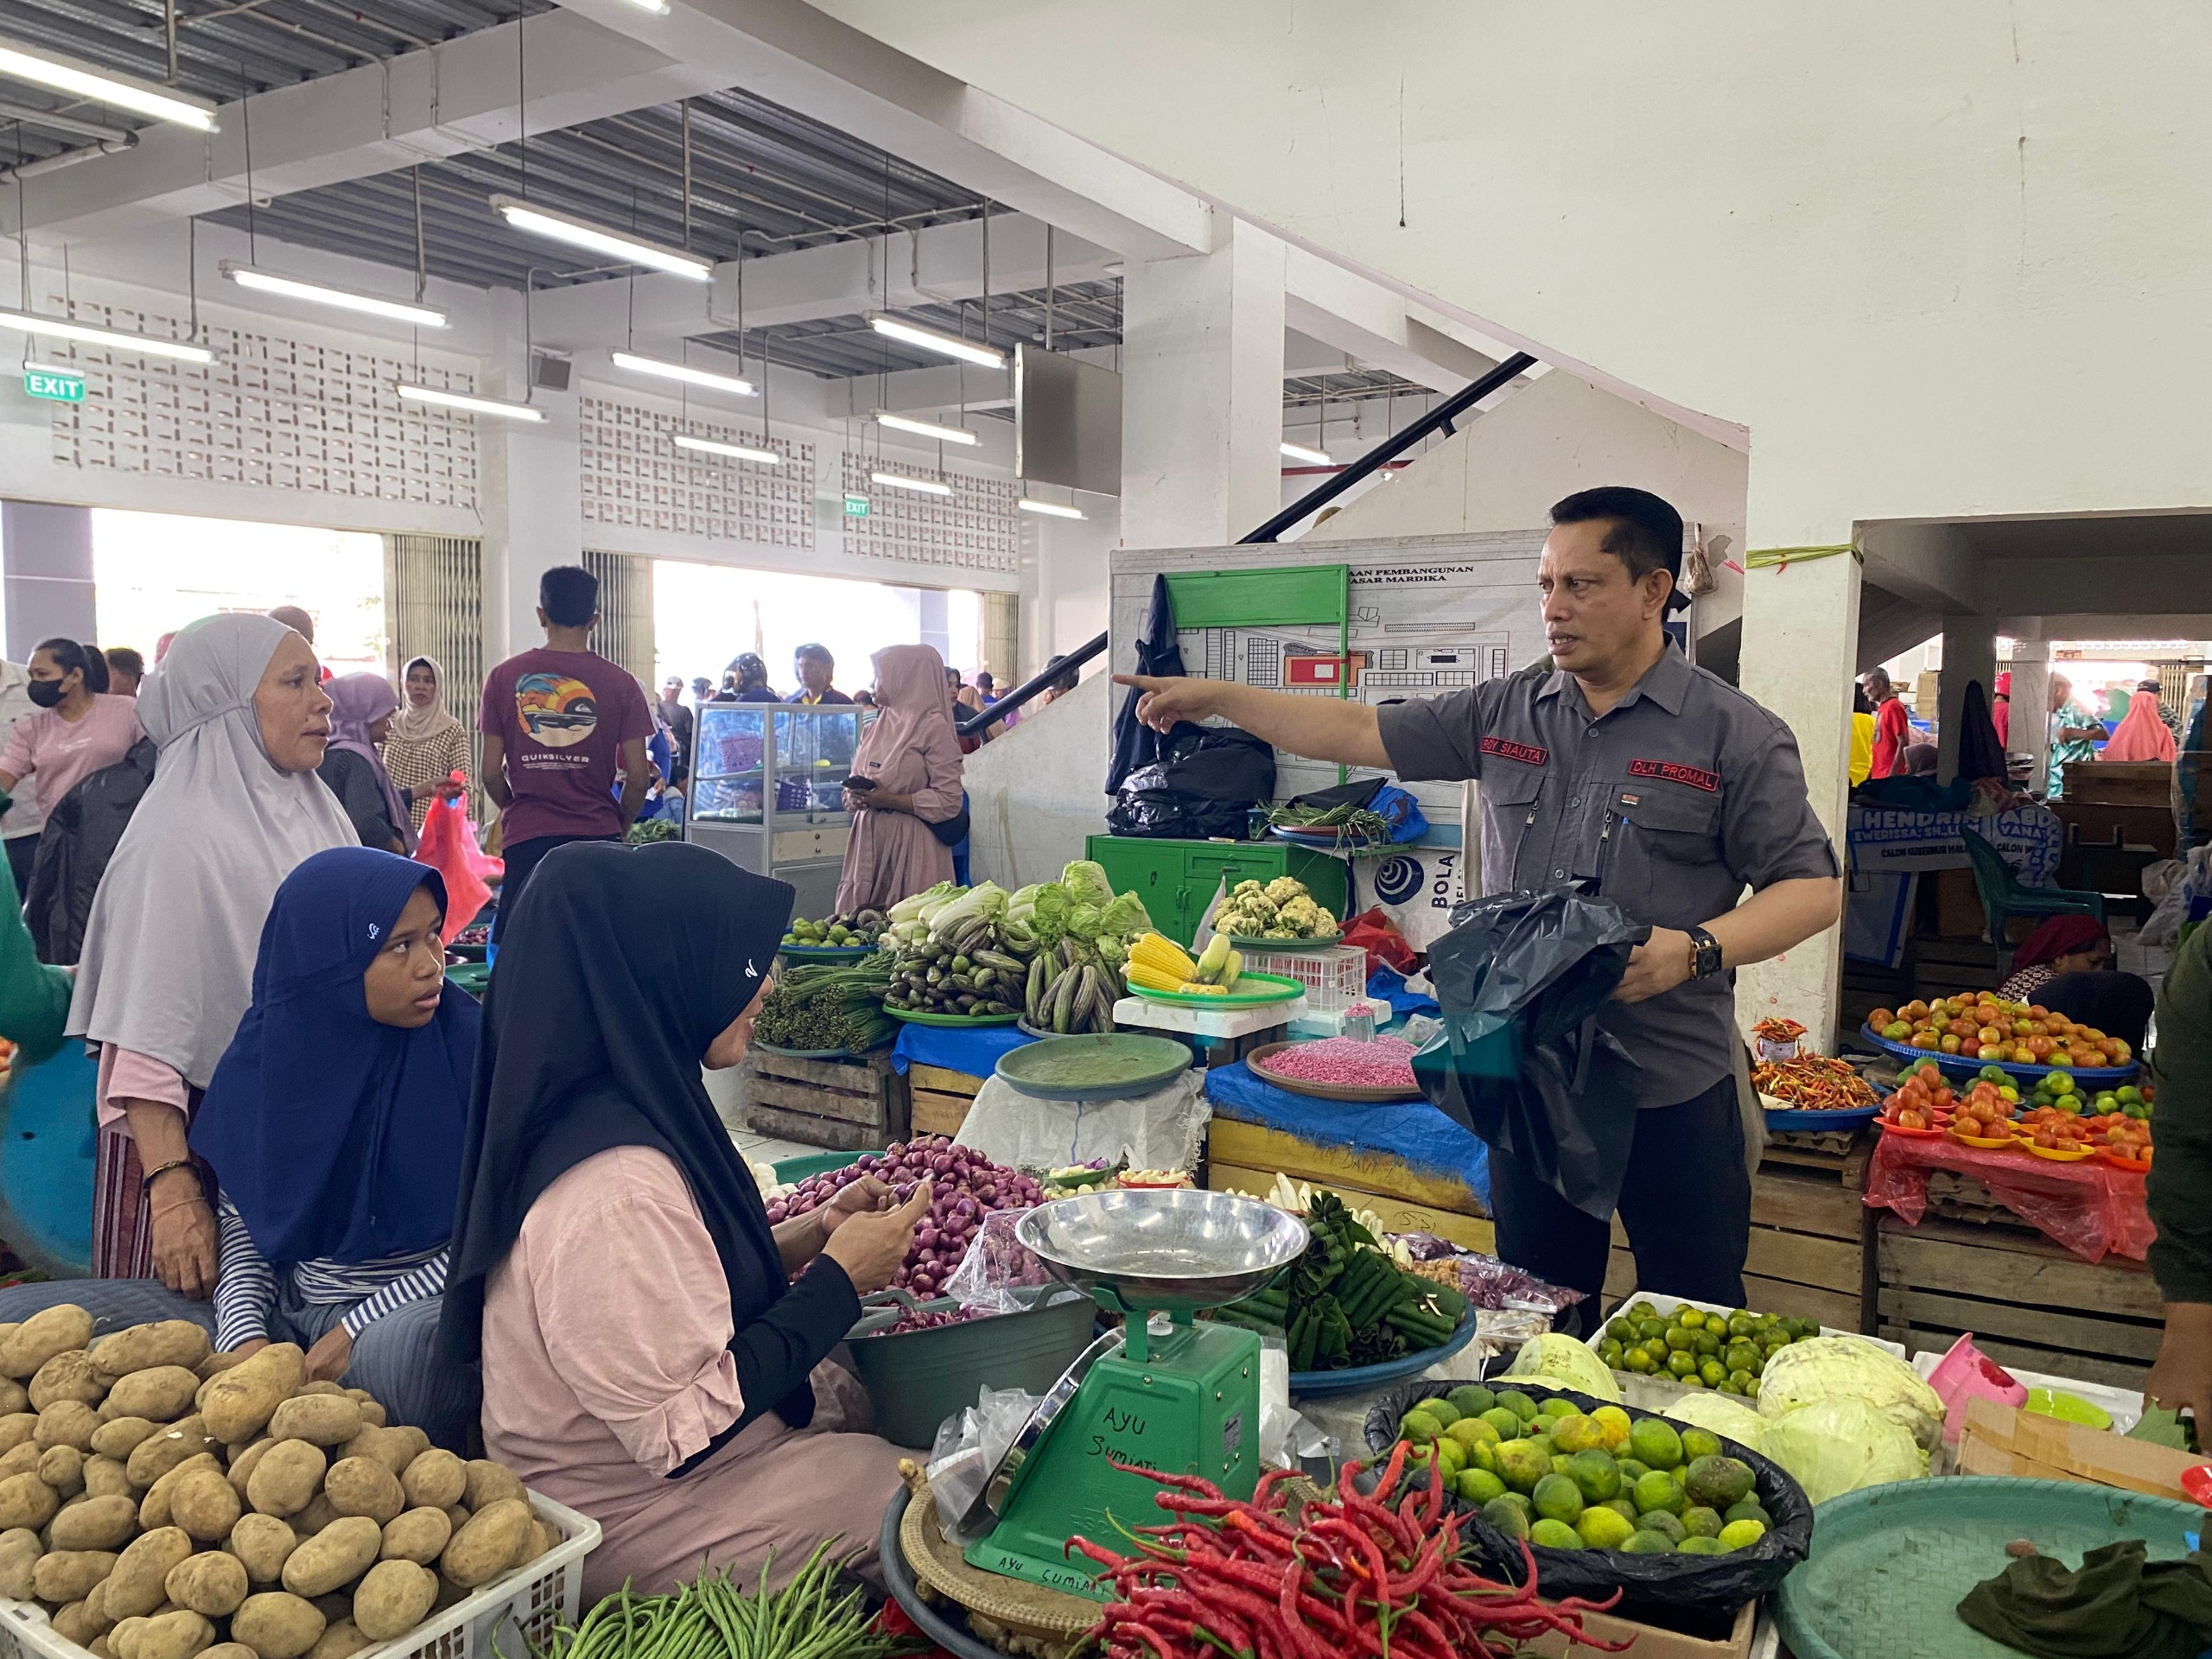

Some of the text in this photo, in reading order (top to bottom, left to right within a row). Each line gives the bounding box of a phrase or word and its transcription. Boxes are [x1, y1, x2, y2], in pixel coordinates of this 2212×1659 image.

[29, 375, 79, 397] EXIT
[846, 502, 867, 514] EXIT
[521, 753, 590, 763] QUIKSILVER
[1482, 739, 1541, 762] ROY SIAUTA
[1632, 761, 1713, 787] DLH PROMAL
[1881, 849, 1906, 858] CALON
[1997, 842, 2023, 853] CALON
[1432, 855, 1455, 908] BOLA
[1103, 1407, 1146, 1435] AYU
[999, 1557, 1024, 1571] AYU
